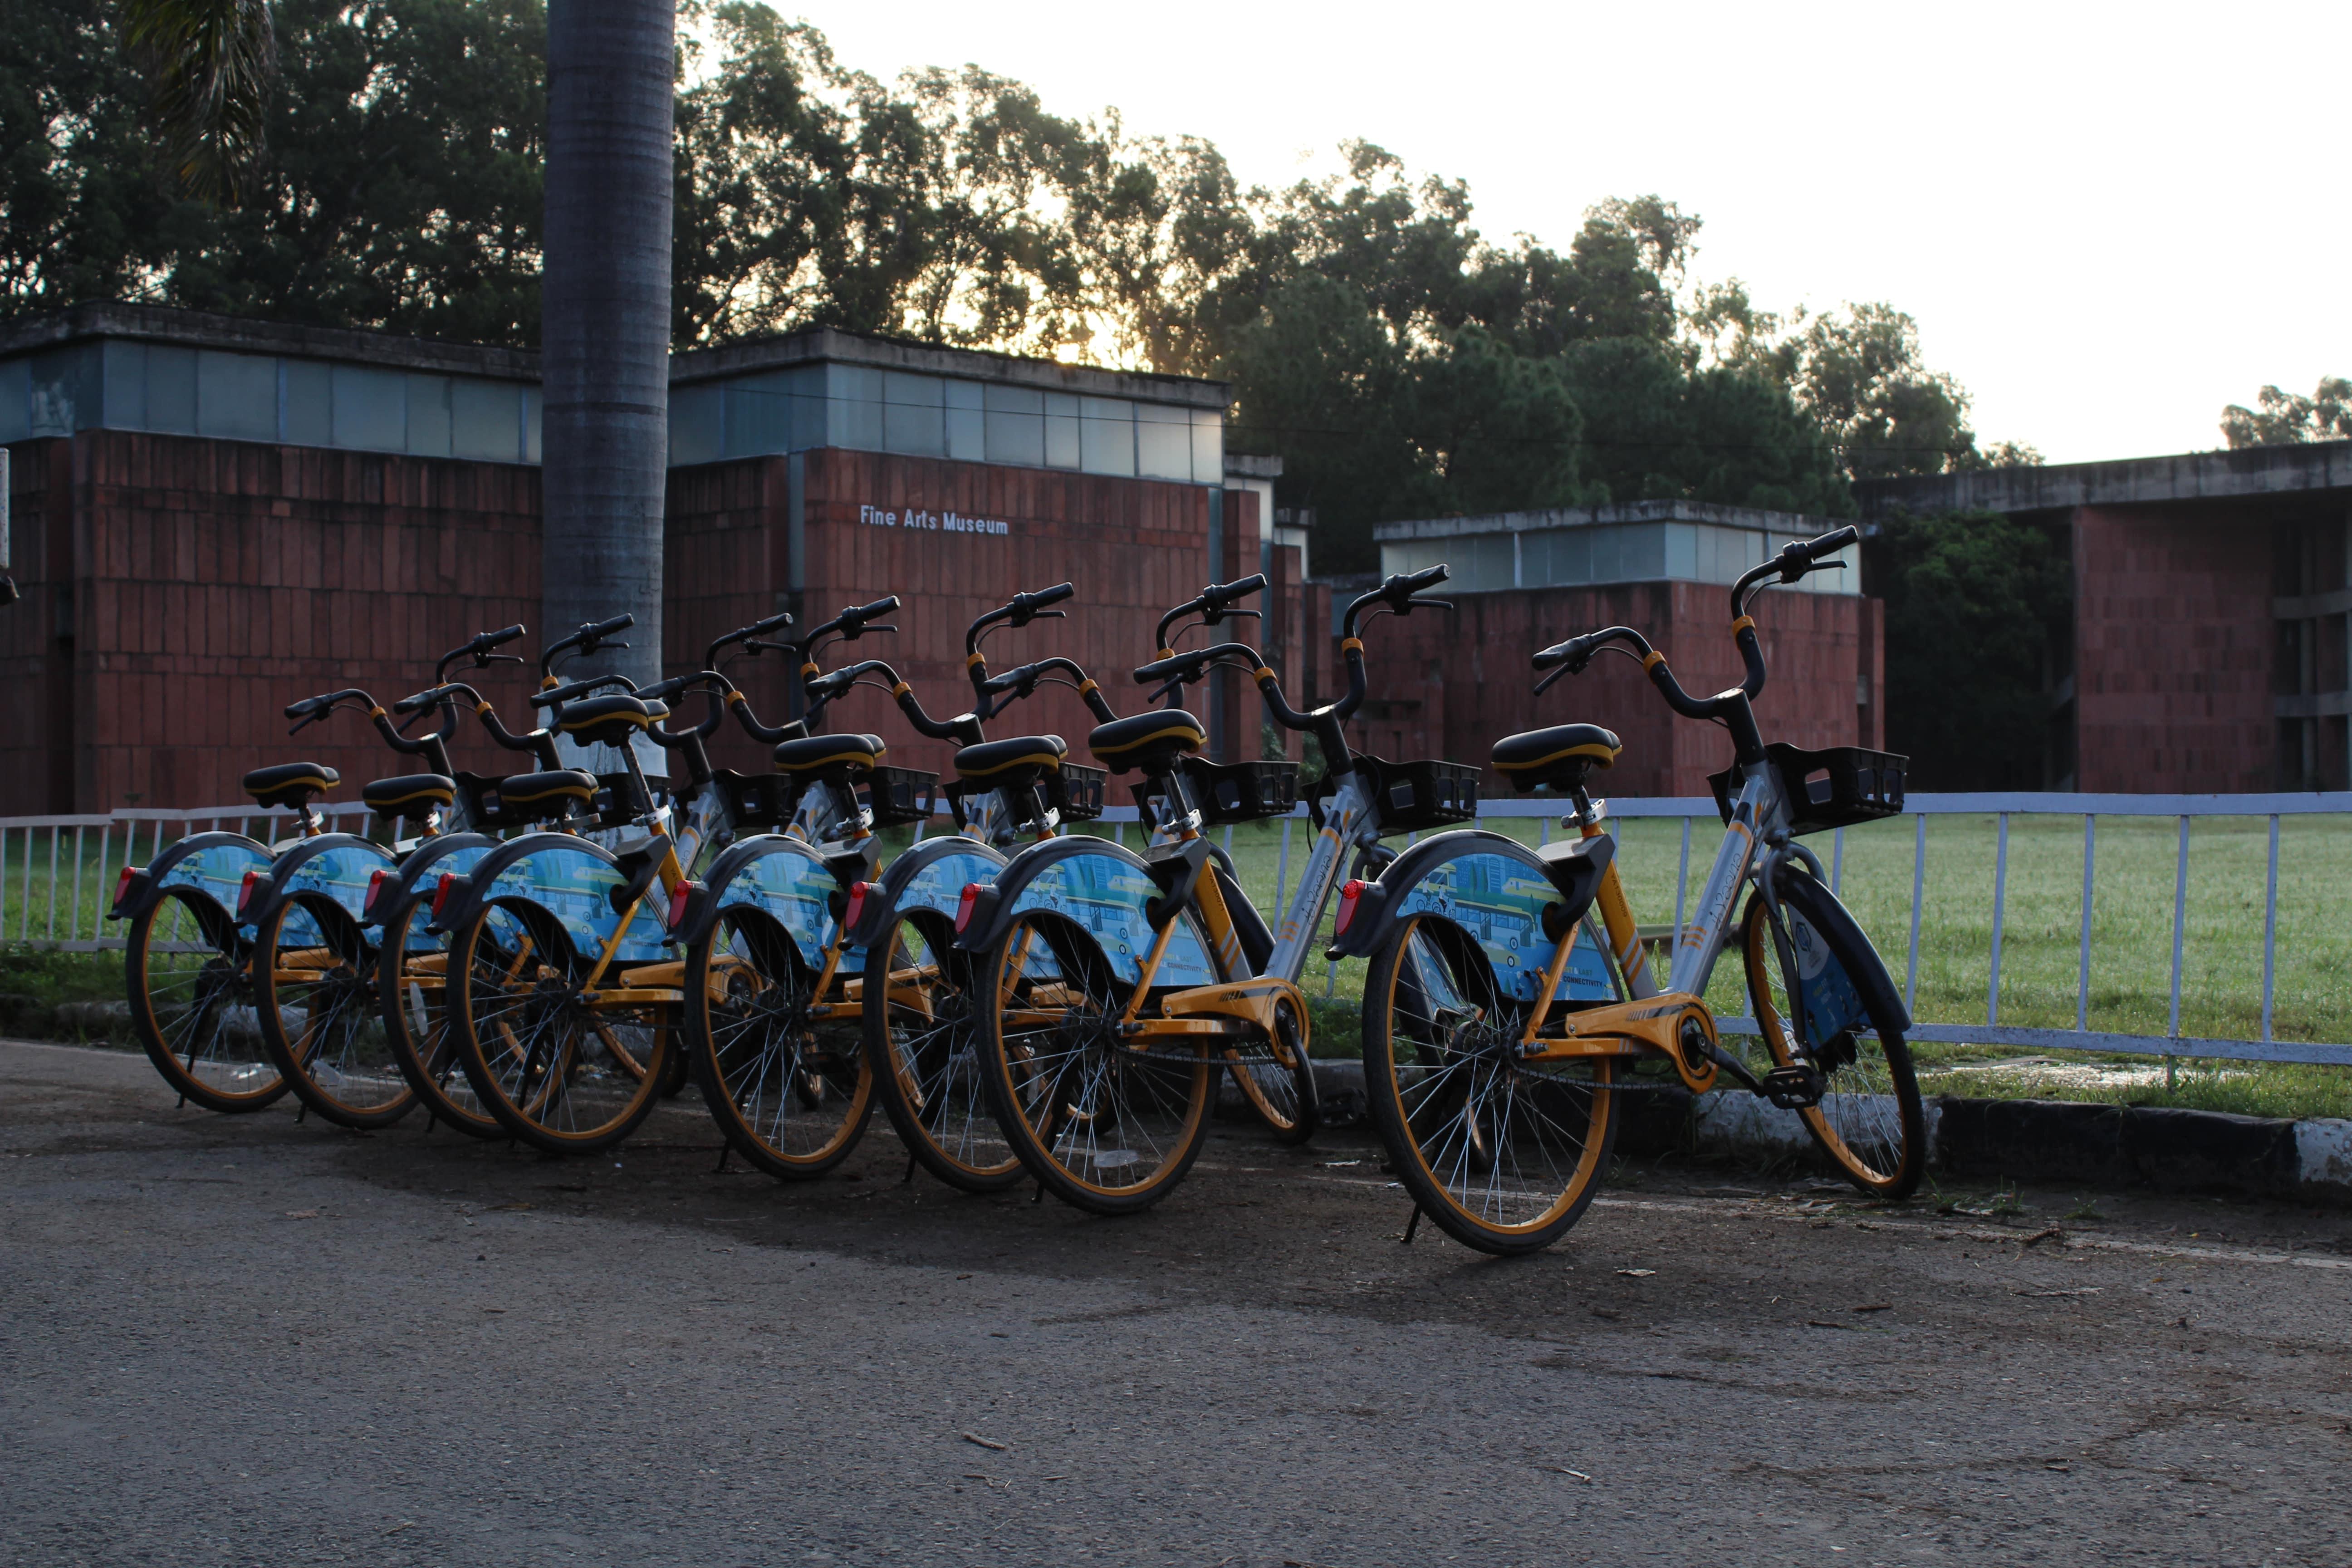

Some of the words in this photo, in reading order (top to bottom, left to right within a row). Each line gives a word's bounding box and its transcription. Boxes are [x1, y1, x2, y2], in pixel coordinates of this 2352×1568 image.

[861, 505, 896, 525] Fine
[904, 509, 937, 530] Arts
[943, 512, 1009, 534] Museum
[1168, 962, 1201, 972] CONNECTIVITY
[1563, 975, 1603, 988] CONNECTIVITY
